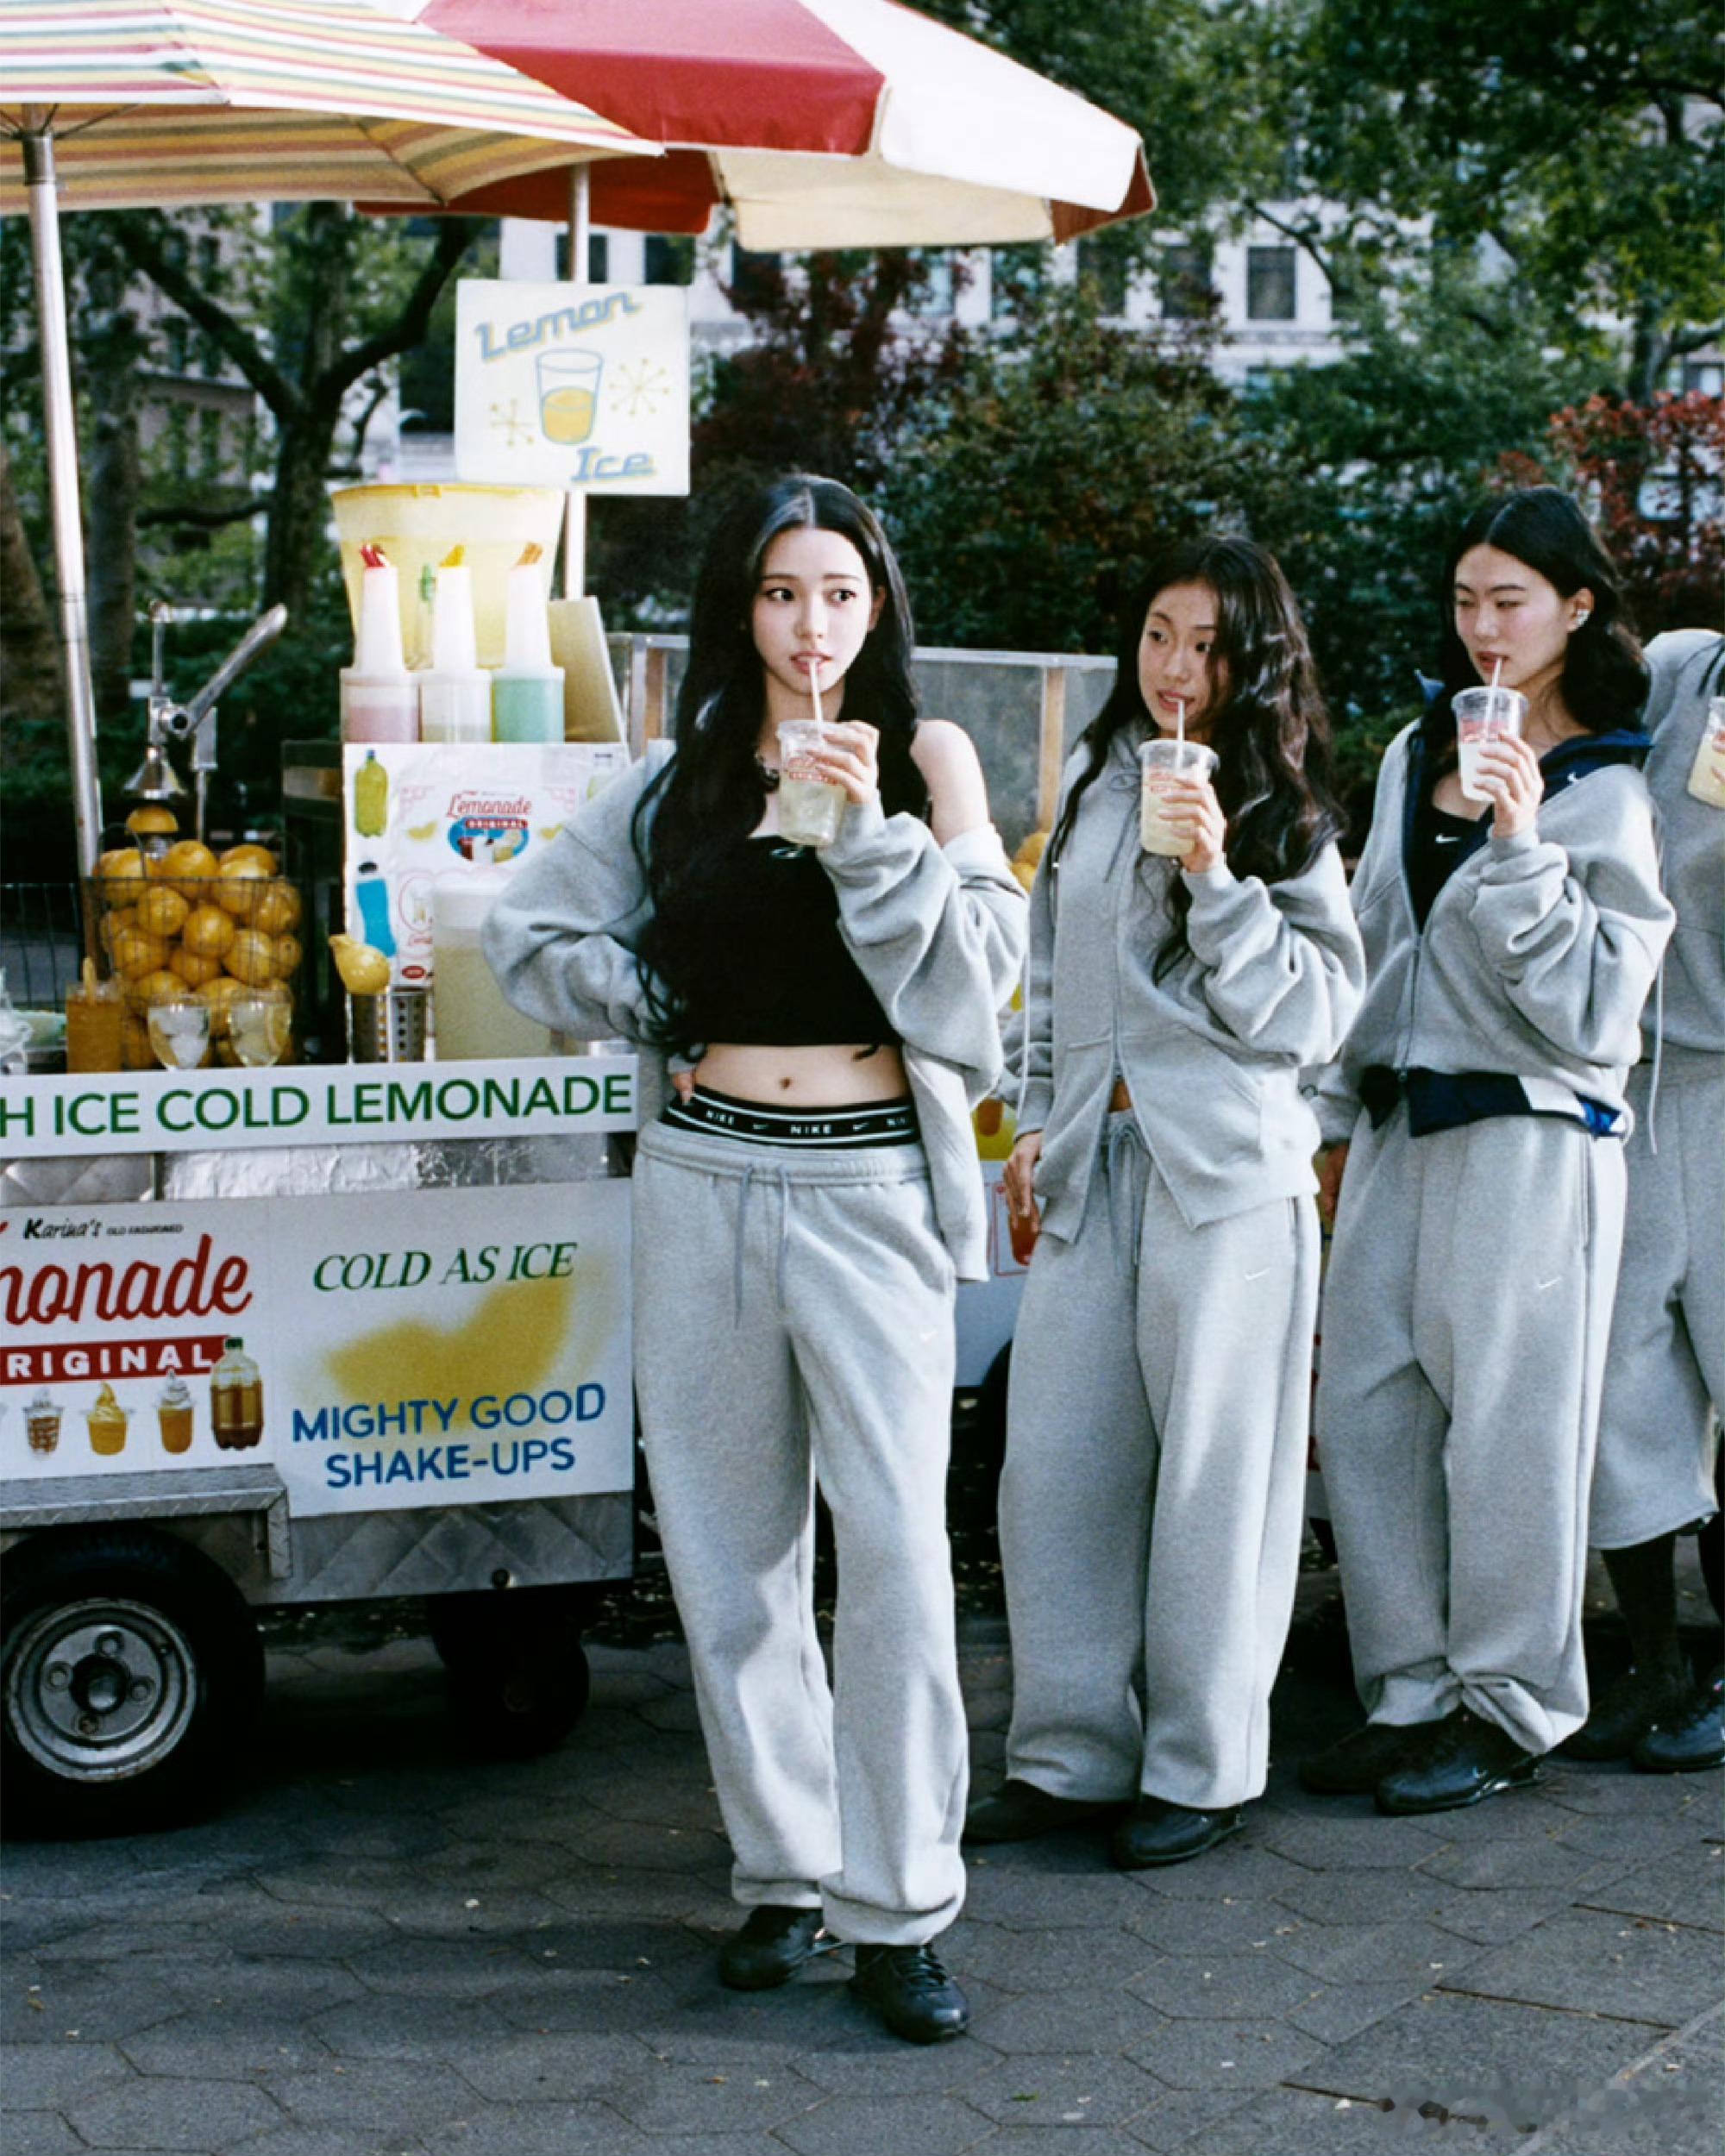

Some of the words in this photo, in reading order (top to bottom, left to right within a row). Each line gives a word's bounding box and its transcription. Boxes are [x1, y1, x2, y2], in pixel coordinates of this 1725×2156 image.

[475, 291, 641, 362] Lemon
[570, 446, 656, 484] Ice
[53, 1093, 141, 1136] ICE
[157, 1086, 310, 1132] COLD
[327, 1075, 632, 1125] LEMONADE
[790, 1124, 831, 1135] NIKE
[23, 1218, 102, 1239] Karina's
[313, 1250, 431, 1292] COLD
[439, 1245, 500, 1285] AS
[505, 1242, 578, 1282] ICE
[292, 1398, 459, 1443] MIGHTY
[469, 1383, 605, 1429] GOOD
[325, 1438, 575, 1489] SHAKE-UPS
